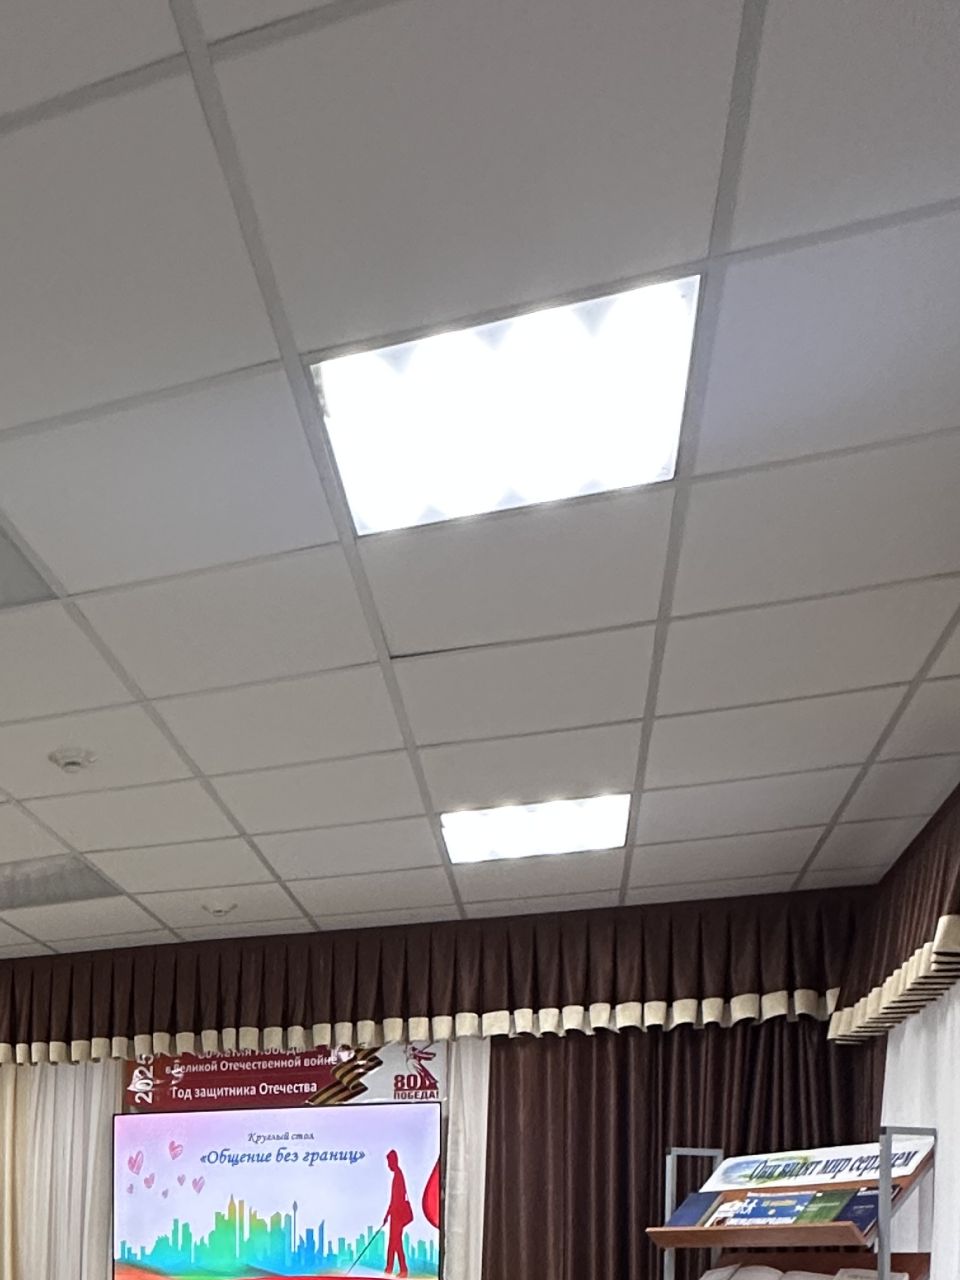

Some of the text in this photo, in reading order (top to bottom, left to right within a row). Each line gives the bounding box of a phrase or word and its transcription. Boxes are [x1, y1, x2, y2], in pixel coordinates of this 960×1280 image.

[220, 1056, 302, 1072] Отечественной
[303, 1055, 337, 1067] войне
[135, 1054, 154, 1104] 2025
[394, 1074, 418, 1090] 80
[172, 1082, 317, 1100] Год защитника Отечества
[393, 1090, 439, 1100] ПОБЕДА!
[247, 1131, 315, 1144] Круглый стол
[200, 1147, 366, 1167] «Общение без границ»
[819, 1156, 851, 1180] мир
[848, 1150, 919, 1178] серем
